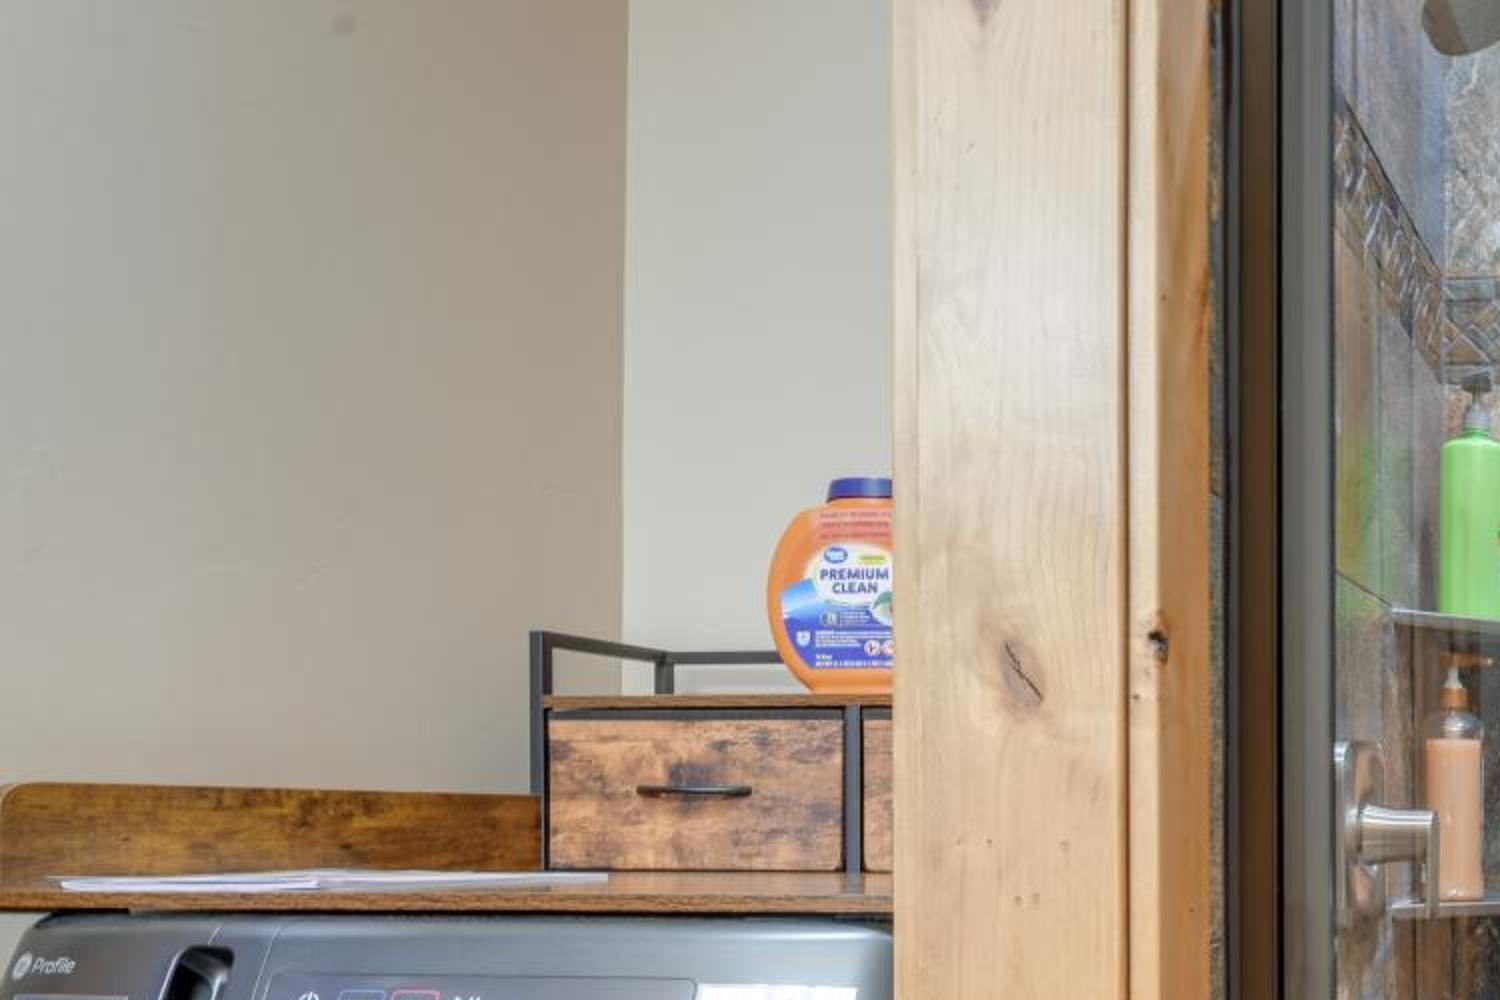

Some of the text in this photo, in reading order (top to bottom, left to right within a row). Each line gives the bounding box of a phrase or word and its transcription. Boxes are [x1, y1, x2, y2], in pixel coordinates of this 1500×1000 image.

[819, 567, 889, 581] PREMIUM
[832, 582, 878, 594] CLEAN
[31, 956, 77, 975] Profile
